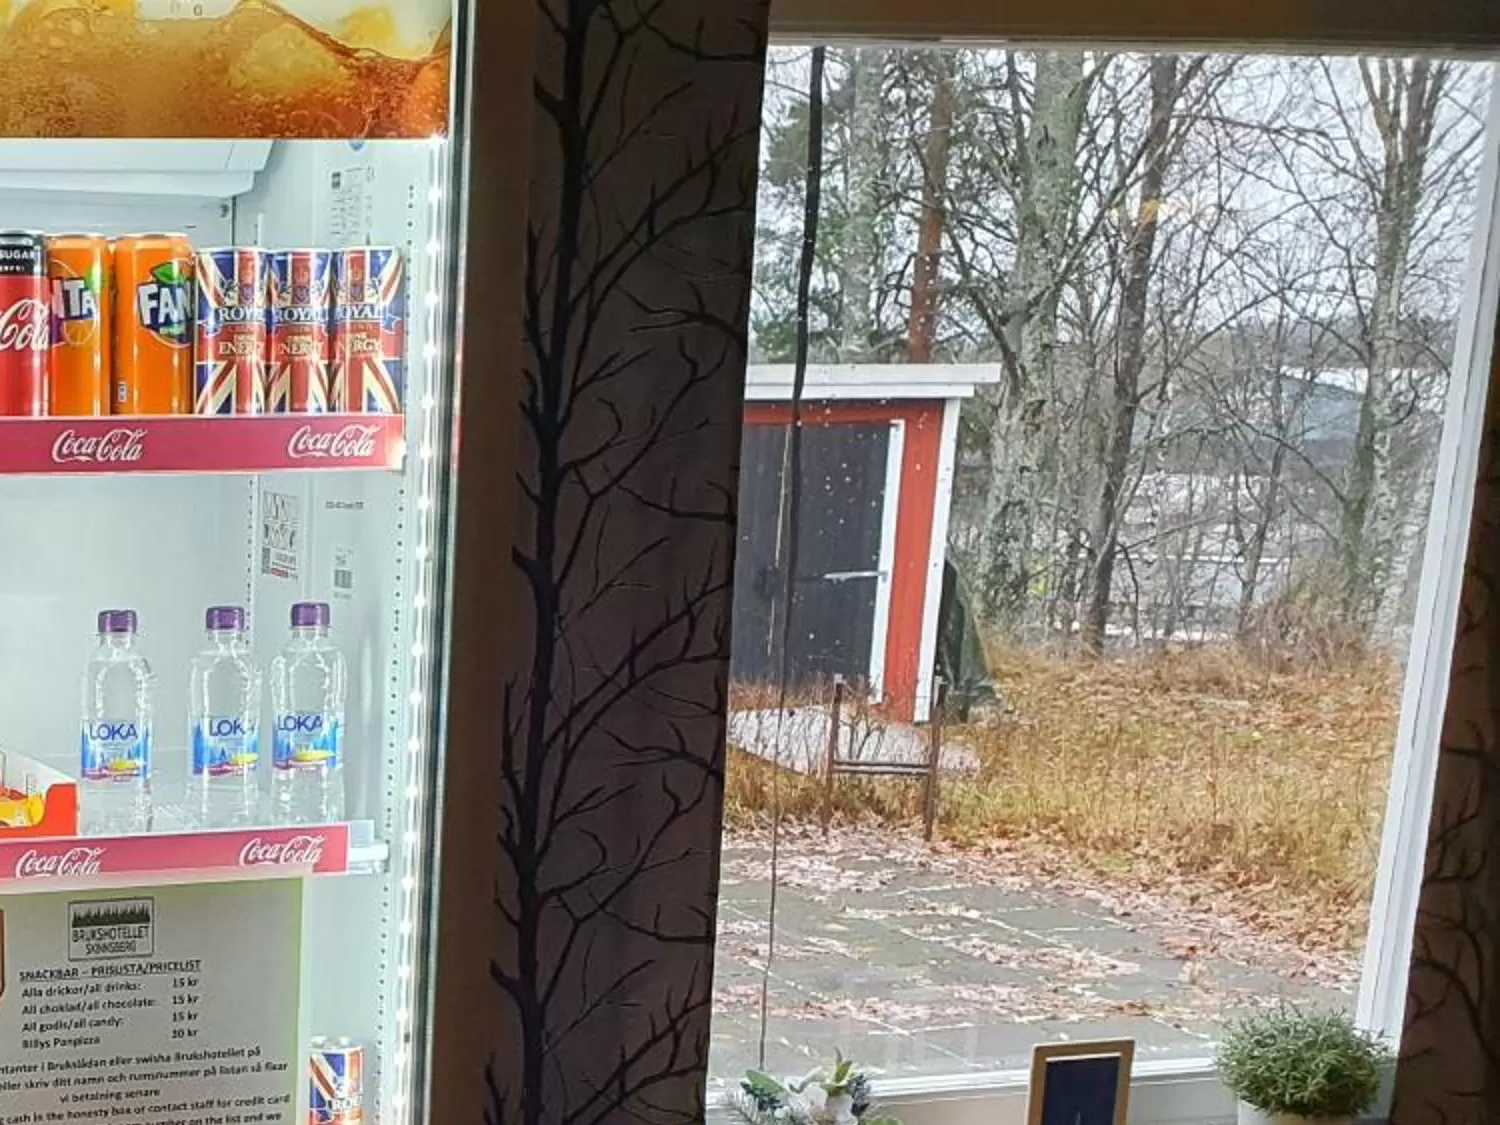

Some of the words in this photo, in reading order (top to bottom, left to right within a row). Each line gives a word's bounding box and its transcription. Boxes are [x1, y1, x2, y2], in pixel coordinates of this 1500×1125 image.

[138, 282, 193, 325] FAN
[51, 429, 146, 463] Coca-Cola
[287, 425, 379, 459] Coca-Cola
[277, 713, 324, 732] LOKA
[88, 723, 139, 741] LOKA
[238, 833, 327, 867] Coca-Cola
[15, 846, 107, 879] Coca-Cola
[19, 967, 79, 982] SNACKBAR
[187, 975, 198, 987] kr
[187, 993, 199, 1004] kr
[187, 1009, 199, 1021] kr
[187, 1027, 199, 1038] kr
[247, 1045, 261, 1058] på
[203, 1067, 217, 1080] på
[46, 1109, 64, 1121] the
[205, 1115, 223, 1125] the
